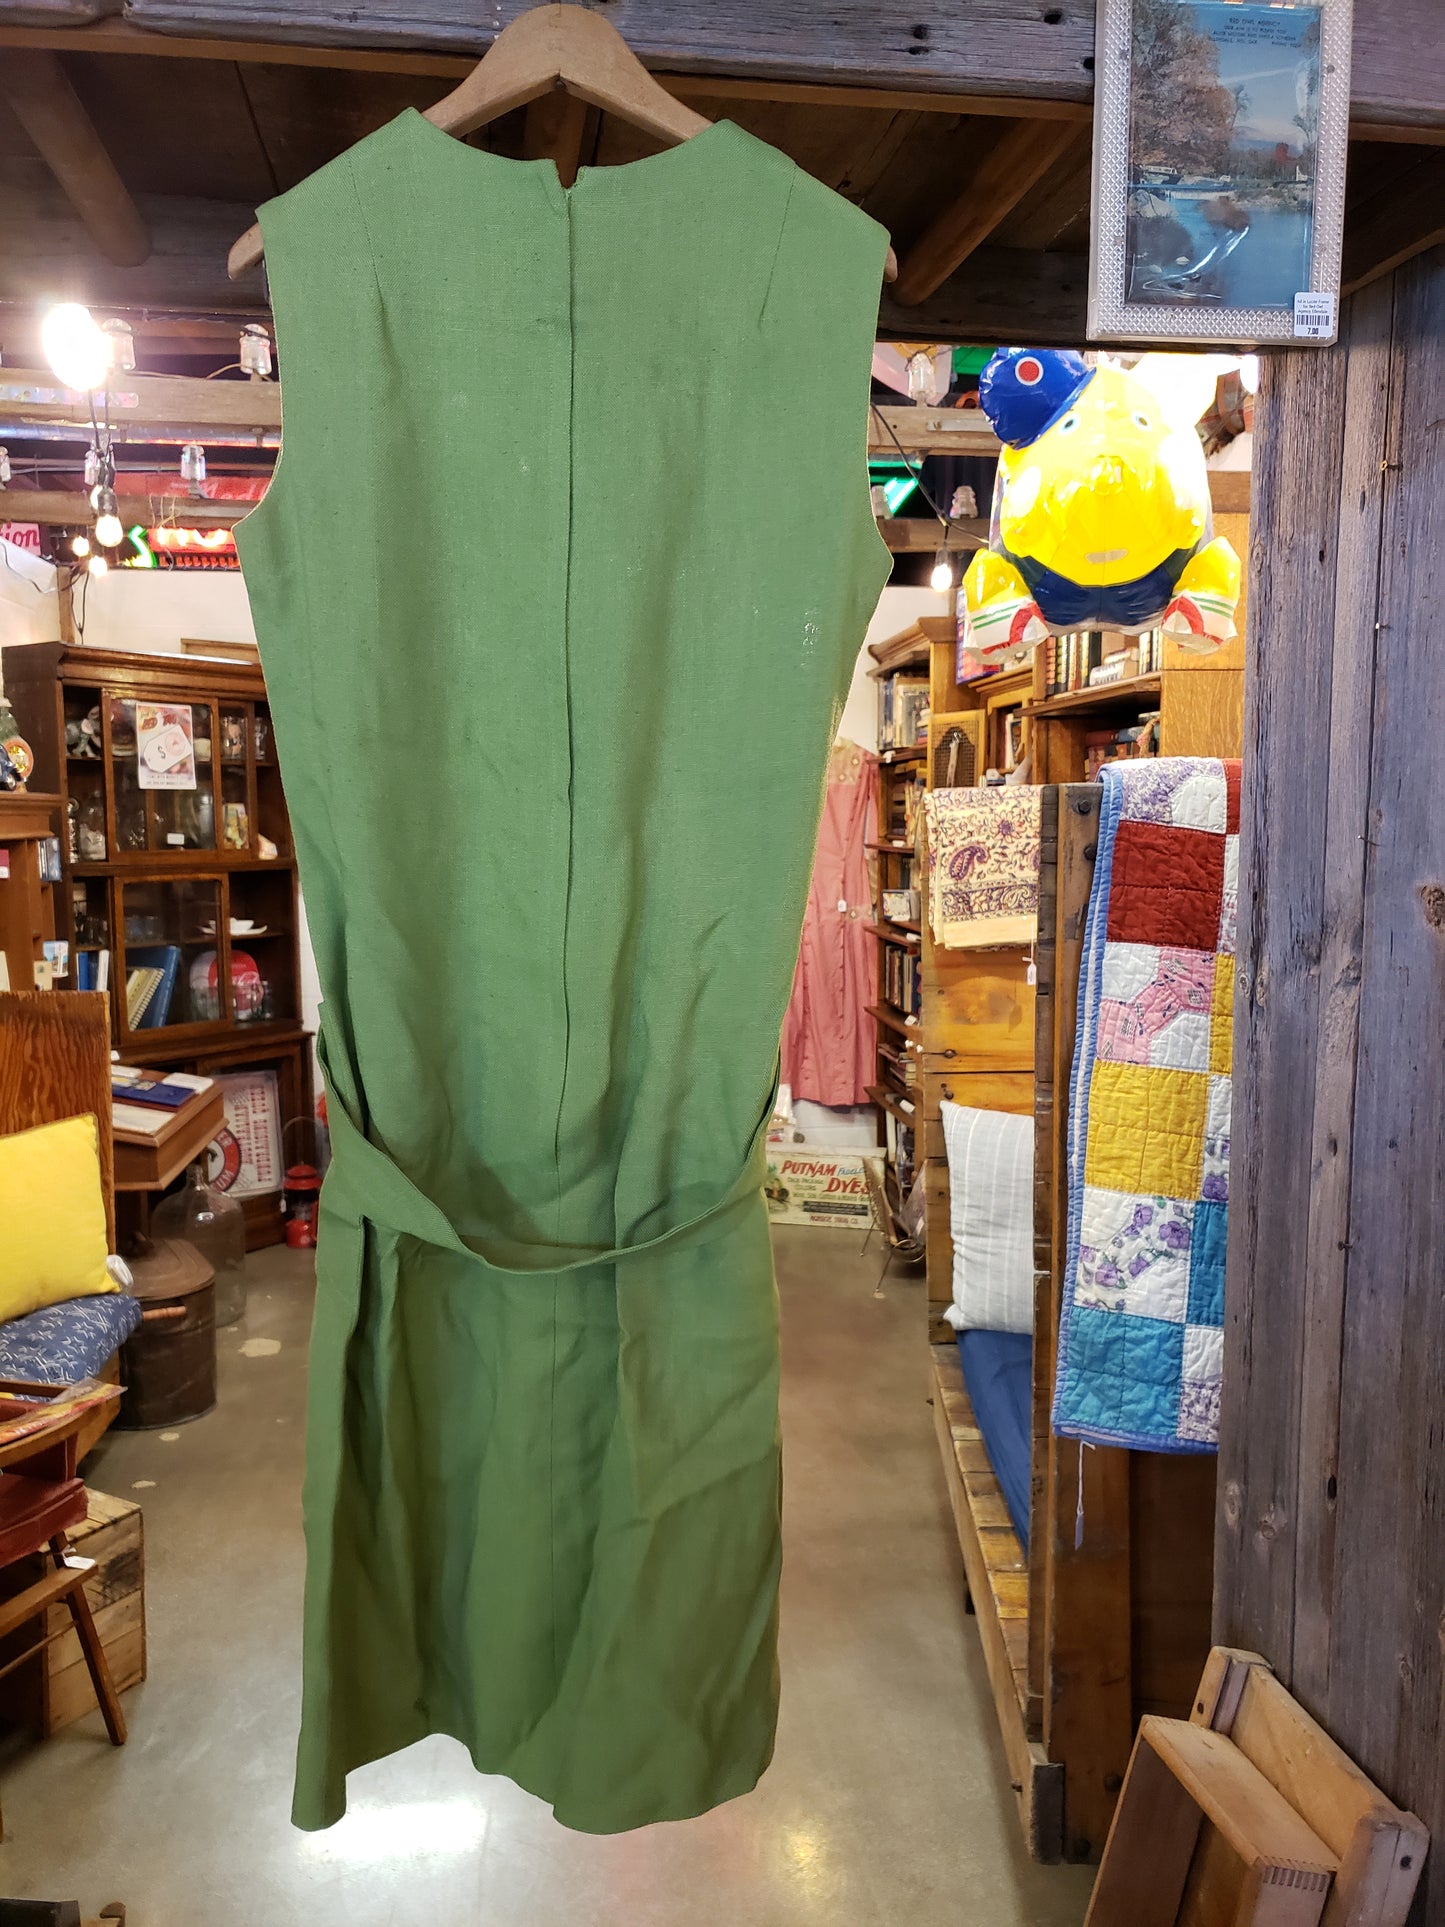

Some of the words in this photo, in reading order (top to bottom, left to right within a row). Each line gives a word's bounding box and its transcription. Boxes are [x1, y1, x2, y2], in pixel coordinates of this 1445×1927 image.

[1307, 327, 1319, 335] 7.00
[781, 1160, 838, 1178] PUTNAM
[822, 1177, 870, 1195] DYES
